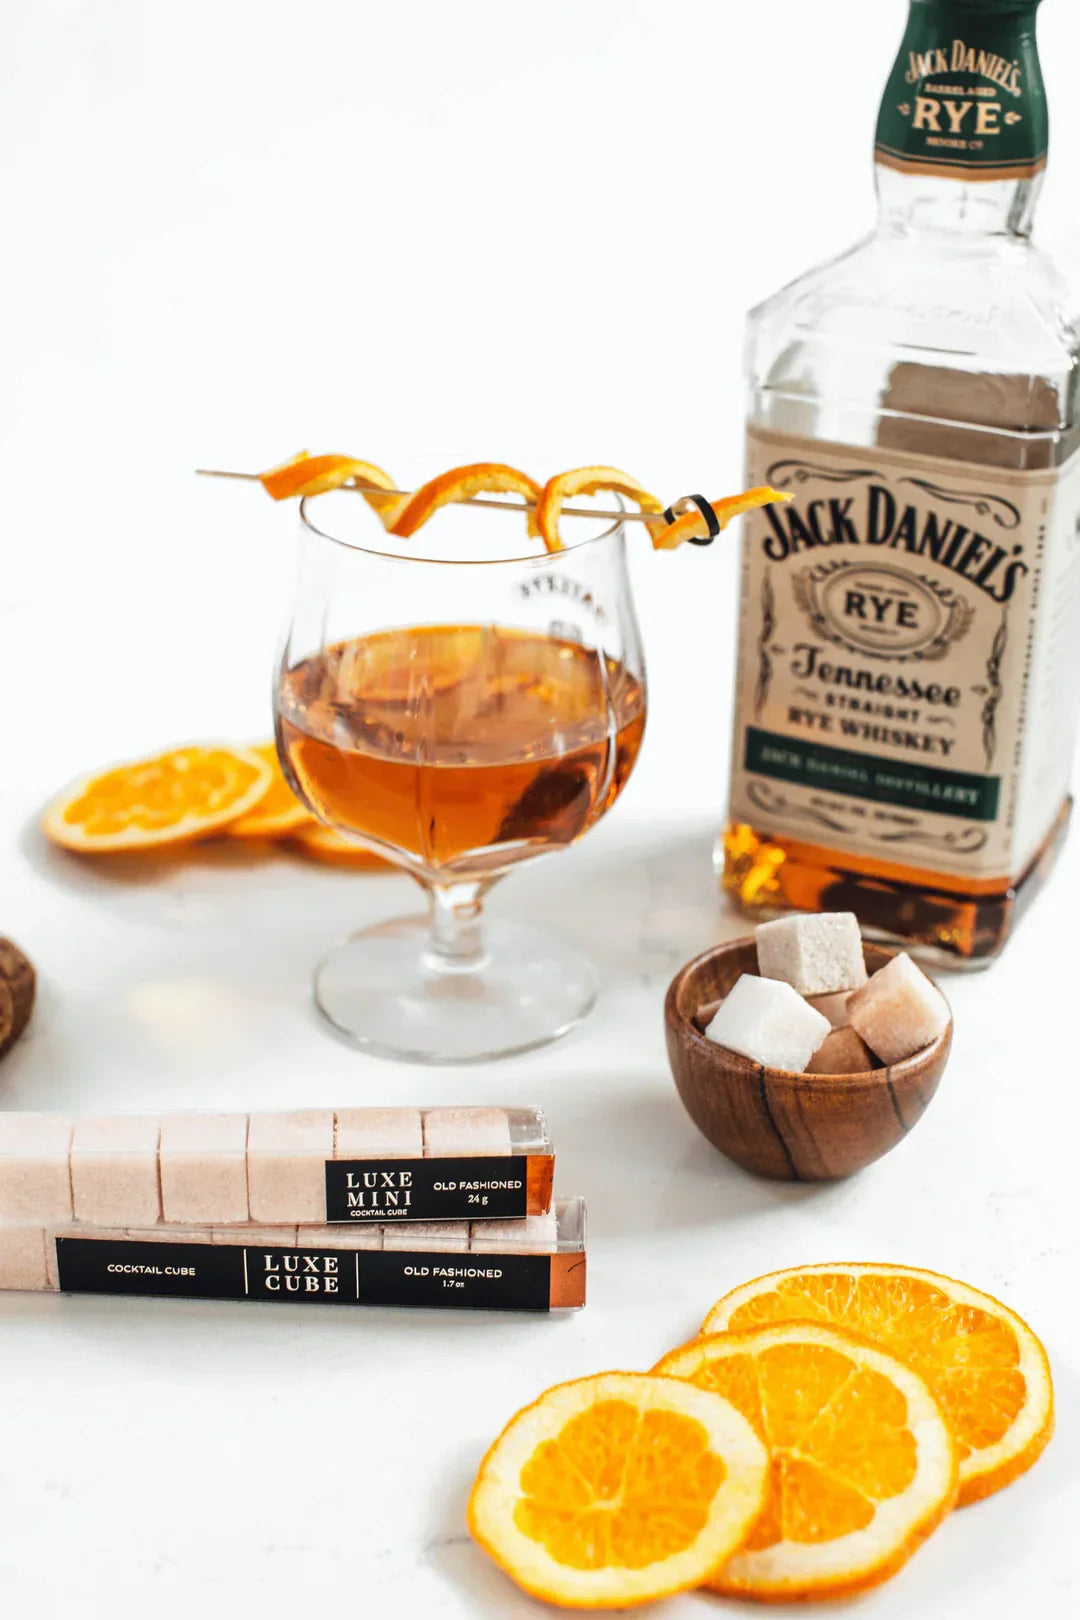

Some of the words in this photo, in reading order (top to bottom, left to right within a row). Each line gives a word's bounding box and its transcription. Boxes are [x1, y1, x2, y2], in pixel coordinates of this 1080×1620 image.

[905, 48, 947, 83] JACK
[912, 96, 1002, 135] RYE
[761, 496, 860, 561] JACK
[867, 484, 1029, 603] DANIEL'S
[844, 590, 920, 629] RYE
[789, 643, 961, 708] Tennessee
[824, 692, 921, 723] STRAIGHT
[787, 706, 833, 731] RYE
[840, 720, 955, 756] WHISKEY
[346, 1171, 413, 1188] LUXE
[433, 1181, 457, 1191] OLD
[459, 1180, 522, 1191] FASHIONED
[346, 1190, 412, 1208] MINI
[467, 1194, 480, 1204] 24
[481, 1195, 489, 1206] g
[350, 1209, 386, 1217] COCKTAIL
[387, 1208, 408, 1216] CUBE
[107, 1263, 163, 1275] COCKTAIL
[164, 1266, 196, 1276] CUBE
[264, 1254, 339, 1273] LUXE
[403, 1266, 430, 1276] OLD
[432, 1267, 503, 1278] FASHIONED
[264, 1274, 339, 1293] CUBE
[442, 1280, 455, 1288] 1.7
